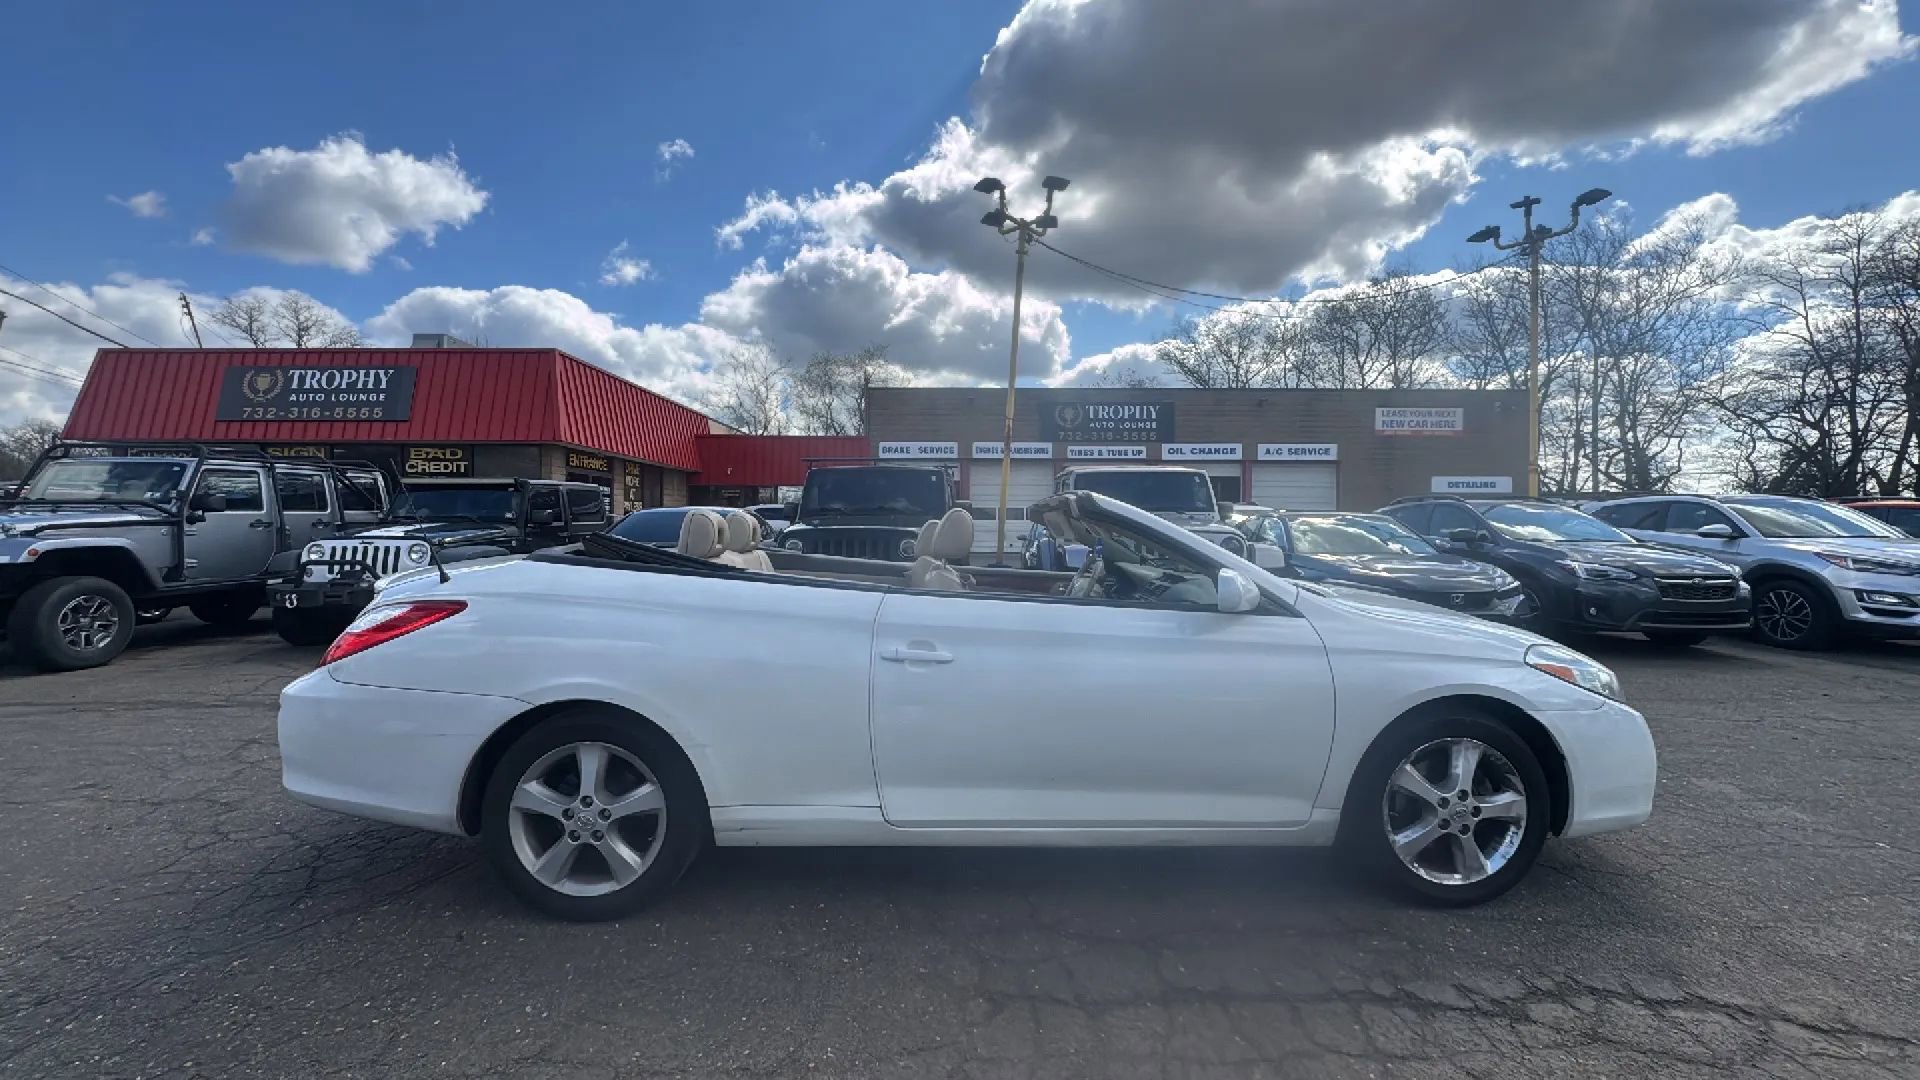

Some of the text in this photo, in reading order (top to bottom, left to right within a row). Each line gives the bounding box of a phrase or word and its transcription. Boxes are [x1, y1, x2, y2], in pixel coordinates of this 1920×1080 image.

[288, 369, 394, 389] TROPHY
[289, 393, 387, 401] AUTO LOUNGE
[242, 407, 384, 419] 732-316-5555
[1085, 405, 1160, 419] TROPHY
[1381, 409, 1408, 418] LEASE
[1409, 409, 1433, 418] YOUR
[1381, 419, 1457, 428] NEW CAR HERE
[1058, 431, 1157, 440] 732-316-5555
[267, 447, 325, 458] SIGN
[409, 447, 463, 459] BAD
[881, 446, 955, 454] BRAKE SERVICE
[1069, 449, 1144, 457] TIRES & TUNE UP
[1167, 447, 1237, 455] OIL CHANGE
[1264, 447, 1331, 455] A/C SERVICE
[569, 453, 609, 471] ENTRANCE
[405, 461, 469, 473] CREDIT
[1447, 481, 1497, 489] DETAILING
